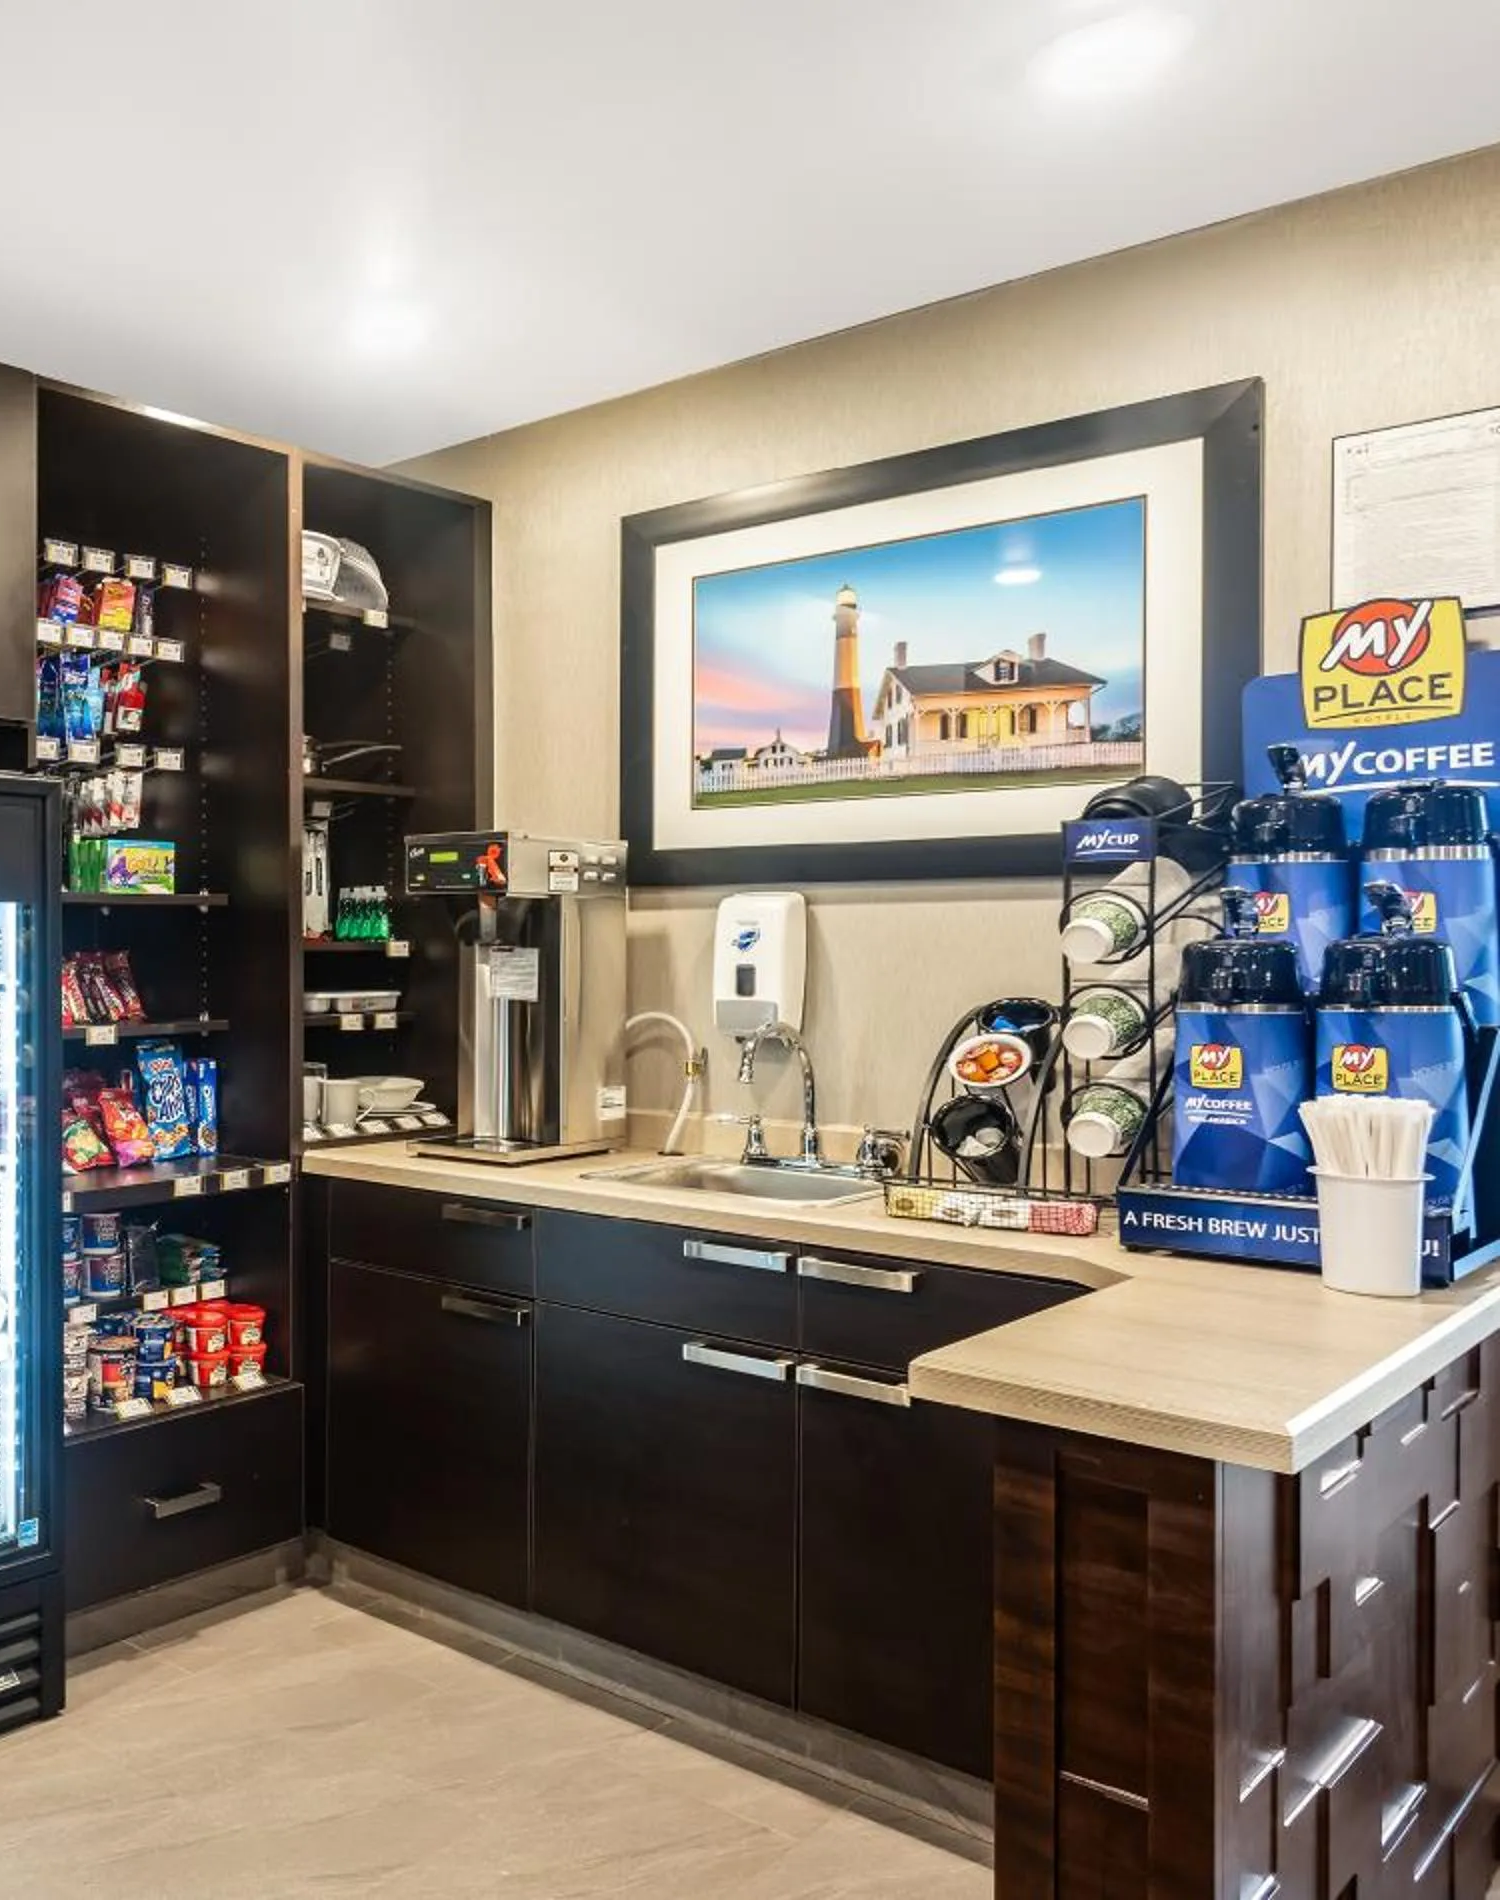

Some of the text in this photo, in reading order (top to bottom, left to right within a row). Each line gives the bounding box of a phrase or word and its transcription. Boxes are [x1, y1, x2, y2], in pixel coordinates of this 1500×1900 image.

[1320, 600, 1434, 672] MY
[1312, 672, 1453, 713] PLACE
[1193, 1071, 1239, 1084] PLACE
[1335, 1073, 1385, 1086] PLACE
[1124, 1211, 1138, 1226] A
[1142, 1211, 1203, 1233] FRESH
[1208, 1218, 1268, 1239] BREW
[1272, 1226, 1320, 1245] JUST
